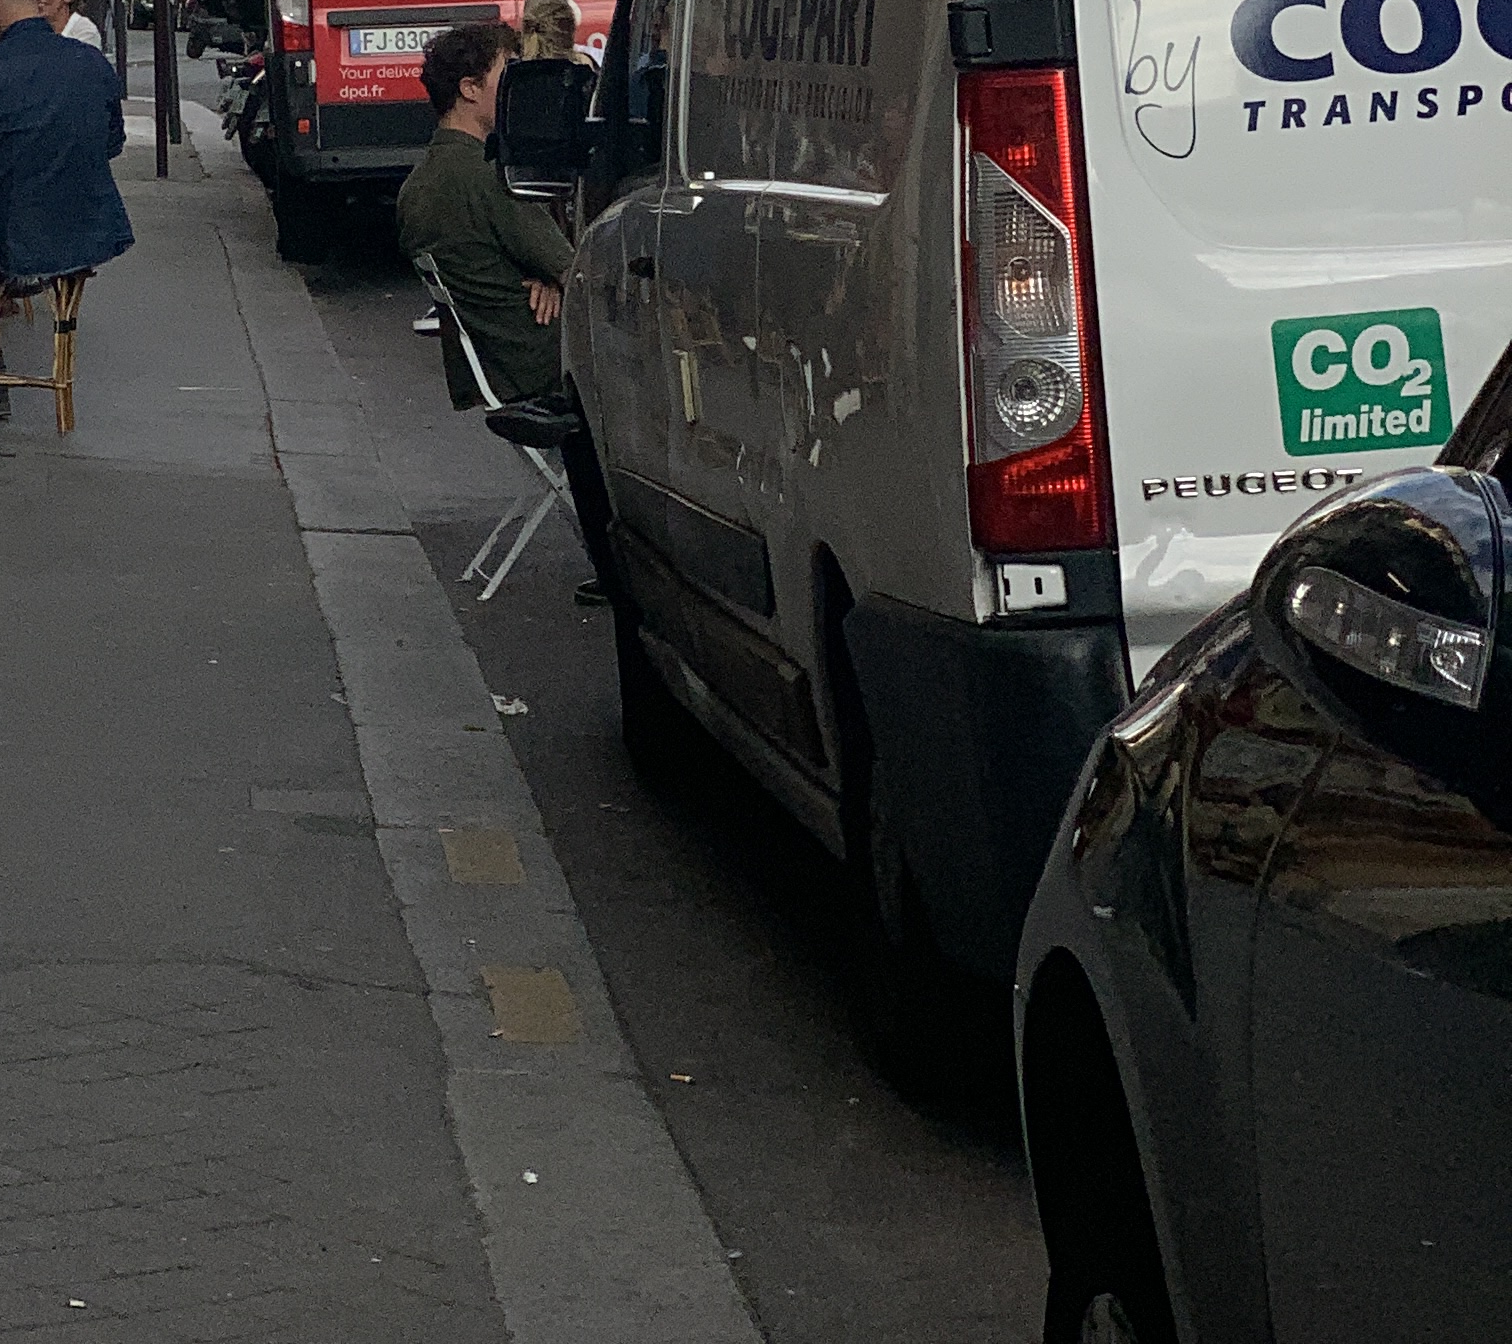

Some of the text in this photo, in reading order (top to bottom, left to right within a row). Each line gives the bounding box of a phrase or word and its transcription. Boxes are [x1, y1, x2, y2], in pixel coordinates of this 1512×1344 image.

[339, 67, 374, 80] Your
[339, 84, 386, 99] dpd.fr
[1300, 398, 1432, 443] limited
[1142, 466, 1364, 502] PEUGEOT
